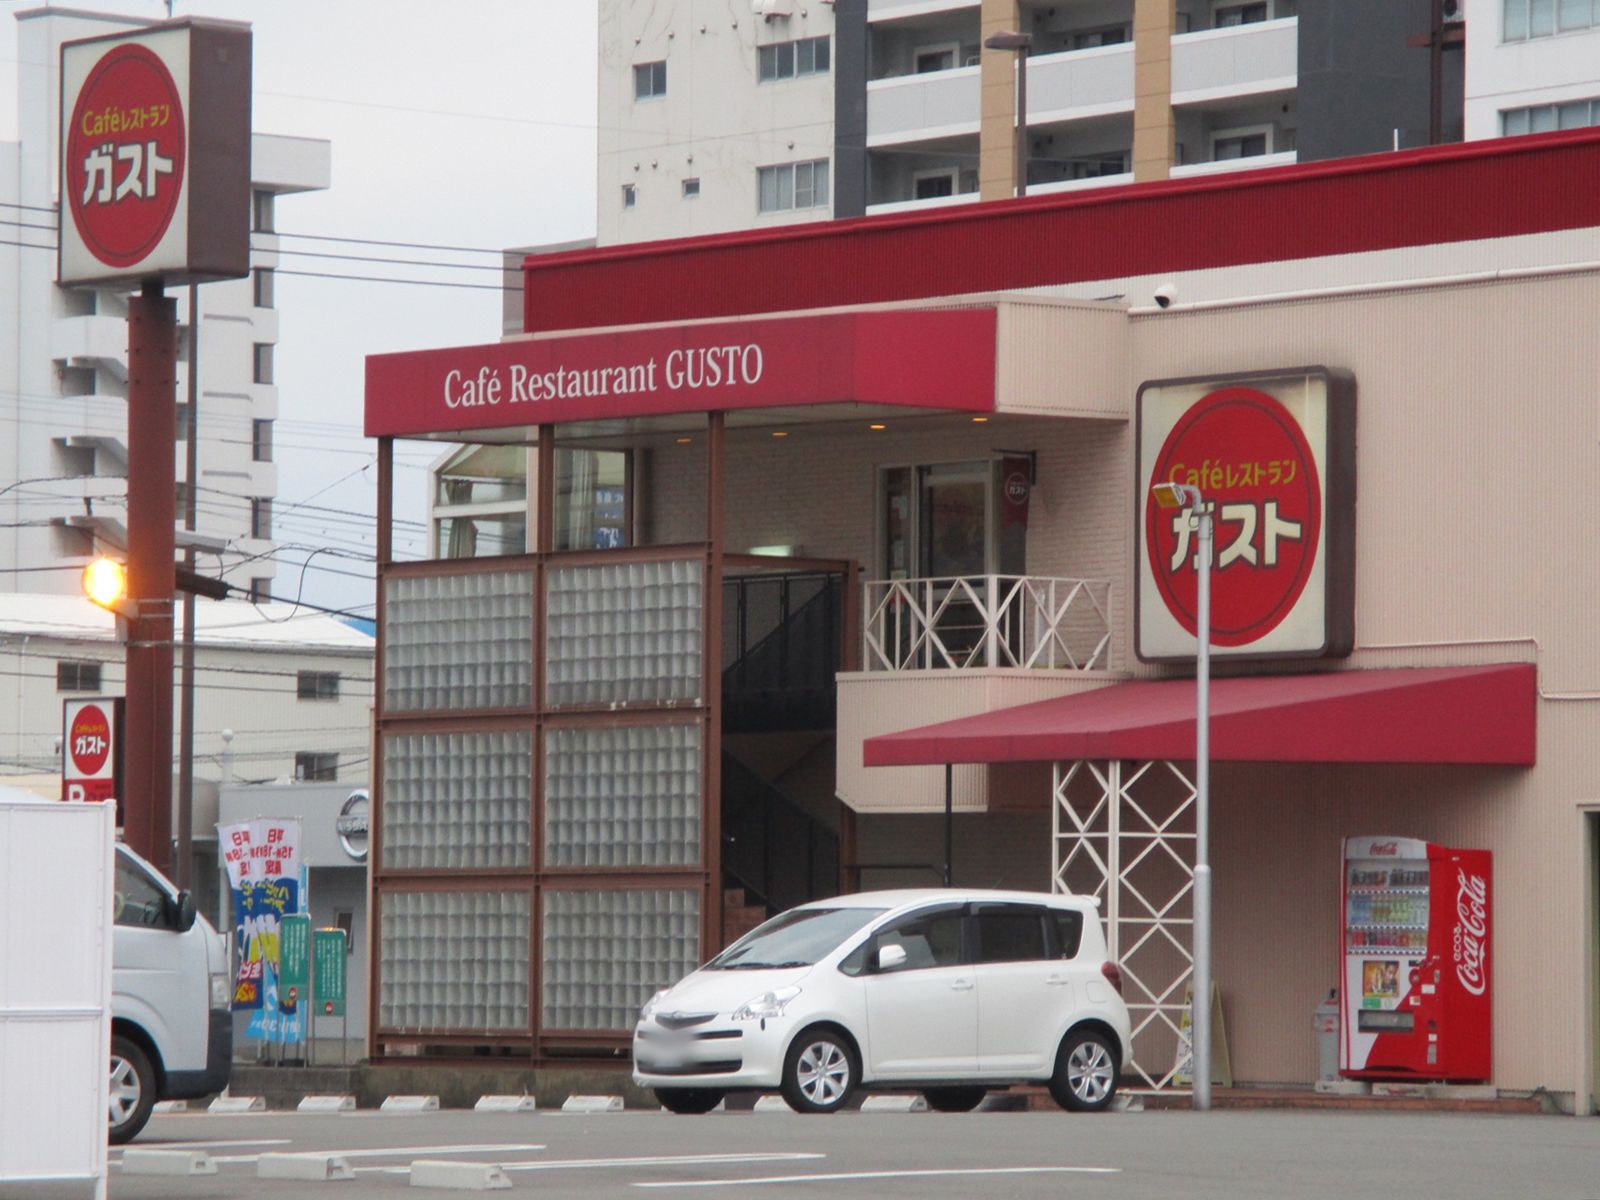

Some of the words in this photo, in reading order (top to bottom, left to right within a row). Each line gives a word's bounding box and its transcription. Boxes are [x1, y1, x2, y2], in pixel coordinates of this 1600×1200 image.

[82, 105, 170, 136] Caféレストラン
[83, 141, 173, 205] ガスト
[444, 366, 501, 408] Café
[509, 357, 657, 403] Restaurant
[665, 344, 763, 389] GUSTO
[1171, 502, 1301, 572] ガスト
[75, 736, 106, 755] ガスト
[1457, 867, 1486, 996] Coca-Cola
